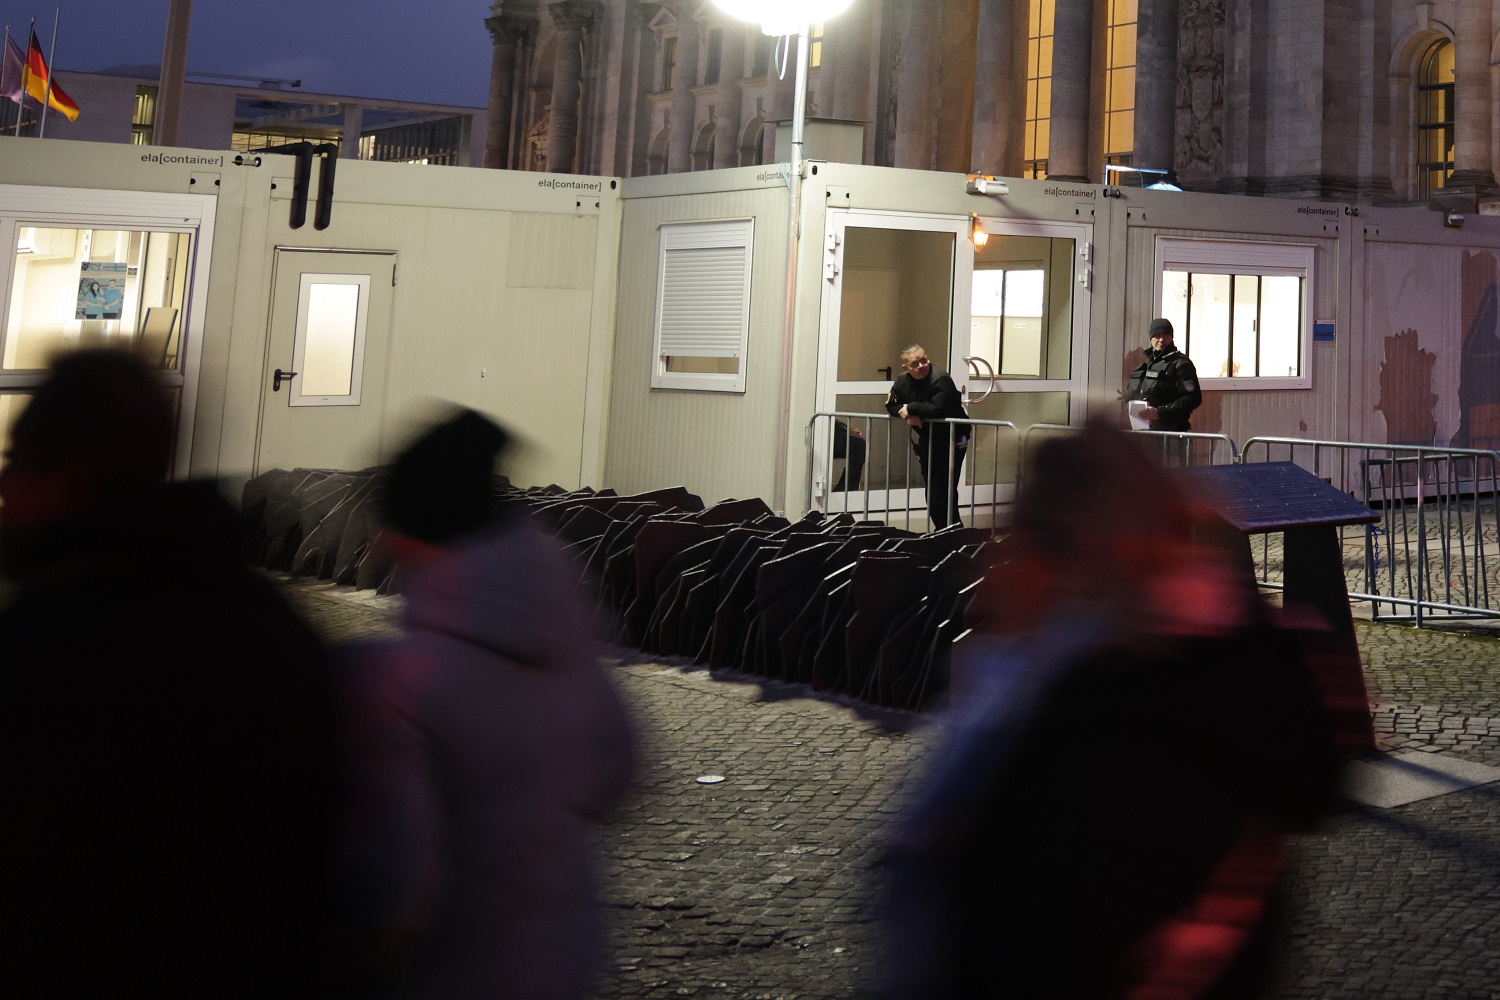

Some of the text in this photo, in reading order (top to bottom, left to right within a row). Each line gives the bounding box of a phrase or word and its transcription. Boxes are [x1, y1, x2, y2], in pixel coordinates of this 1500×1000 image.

[141, 153, 224, 167] ela[container]
[538, 179, 602, 192] ela[container]
[1044, 187, 1097, 200] ela[container]
